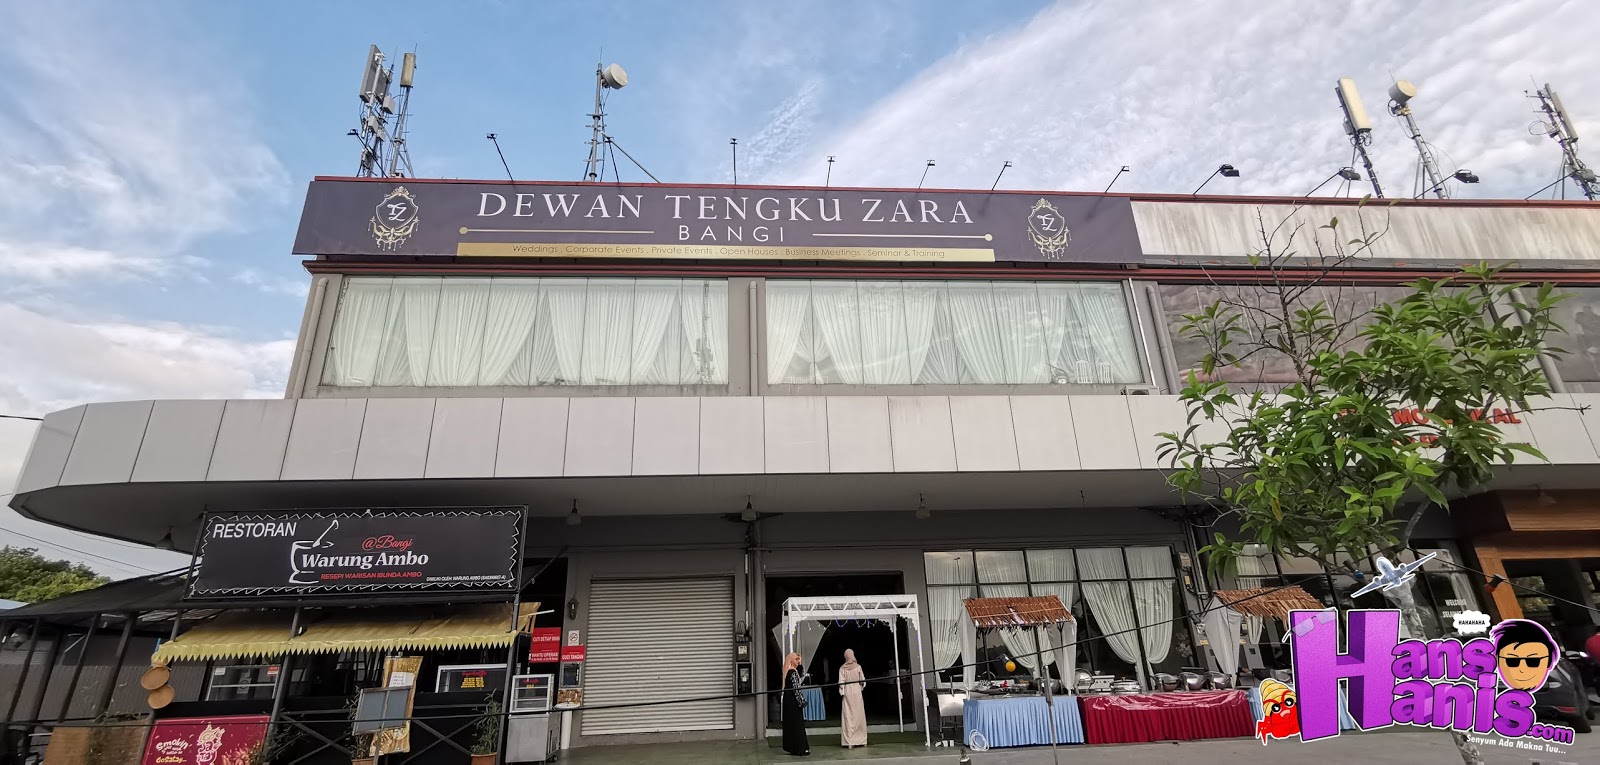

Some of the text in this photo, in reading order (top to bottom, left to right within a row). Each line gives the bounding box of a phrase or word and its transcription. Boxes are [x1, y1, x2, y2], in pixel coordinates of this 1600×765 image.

[477, 192, 974, 224] DEWAN TENGKU ZARA
[678, 225, 784, 243] BANGI
[512, 245, 558, 255] Weddings
[565, 245, 613, 255] Corporate
[615, 246, 644, 254] Events
[651, 246, 682, 255] Private
[684, 246, 713, 255] Events
[719, 247, 746, 256] Open
[747, 247, 779, 256] Houses
[785, 248, 819, 257] Business
[821, 248, 861, 258] Meetings
[867, 249, 902, 257] Seminar
[912, 249, 945, 259] Training
[213, 521, 297, 539] RESTORAN
[362, 534, 414, 551] @Bangi
[301, 551, 429, 570] Warung Ambo
[376, 571, 401, 579] IBUNDA
